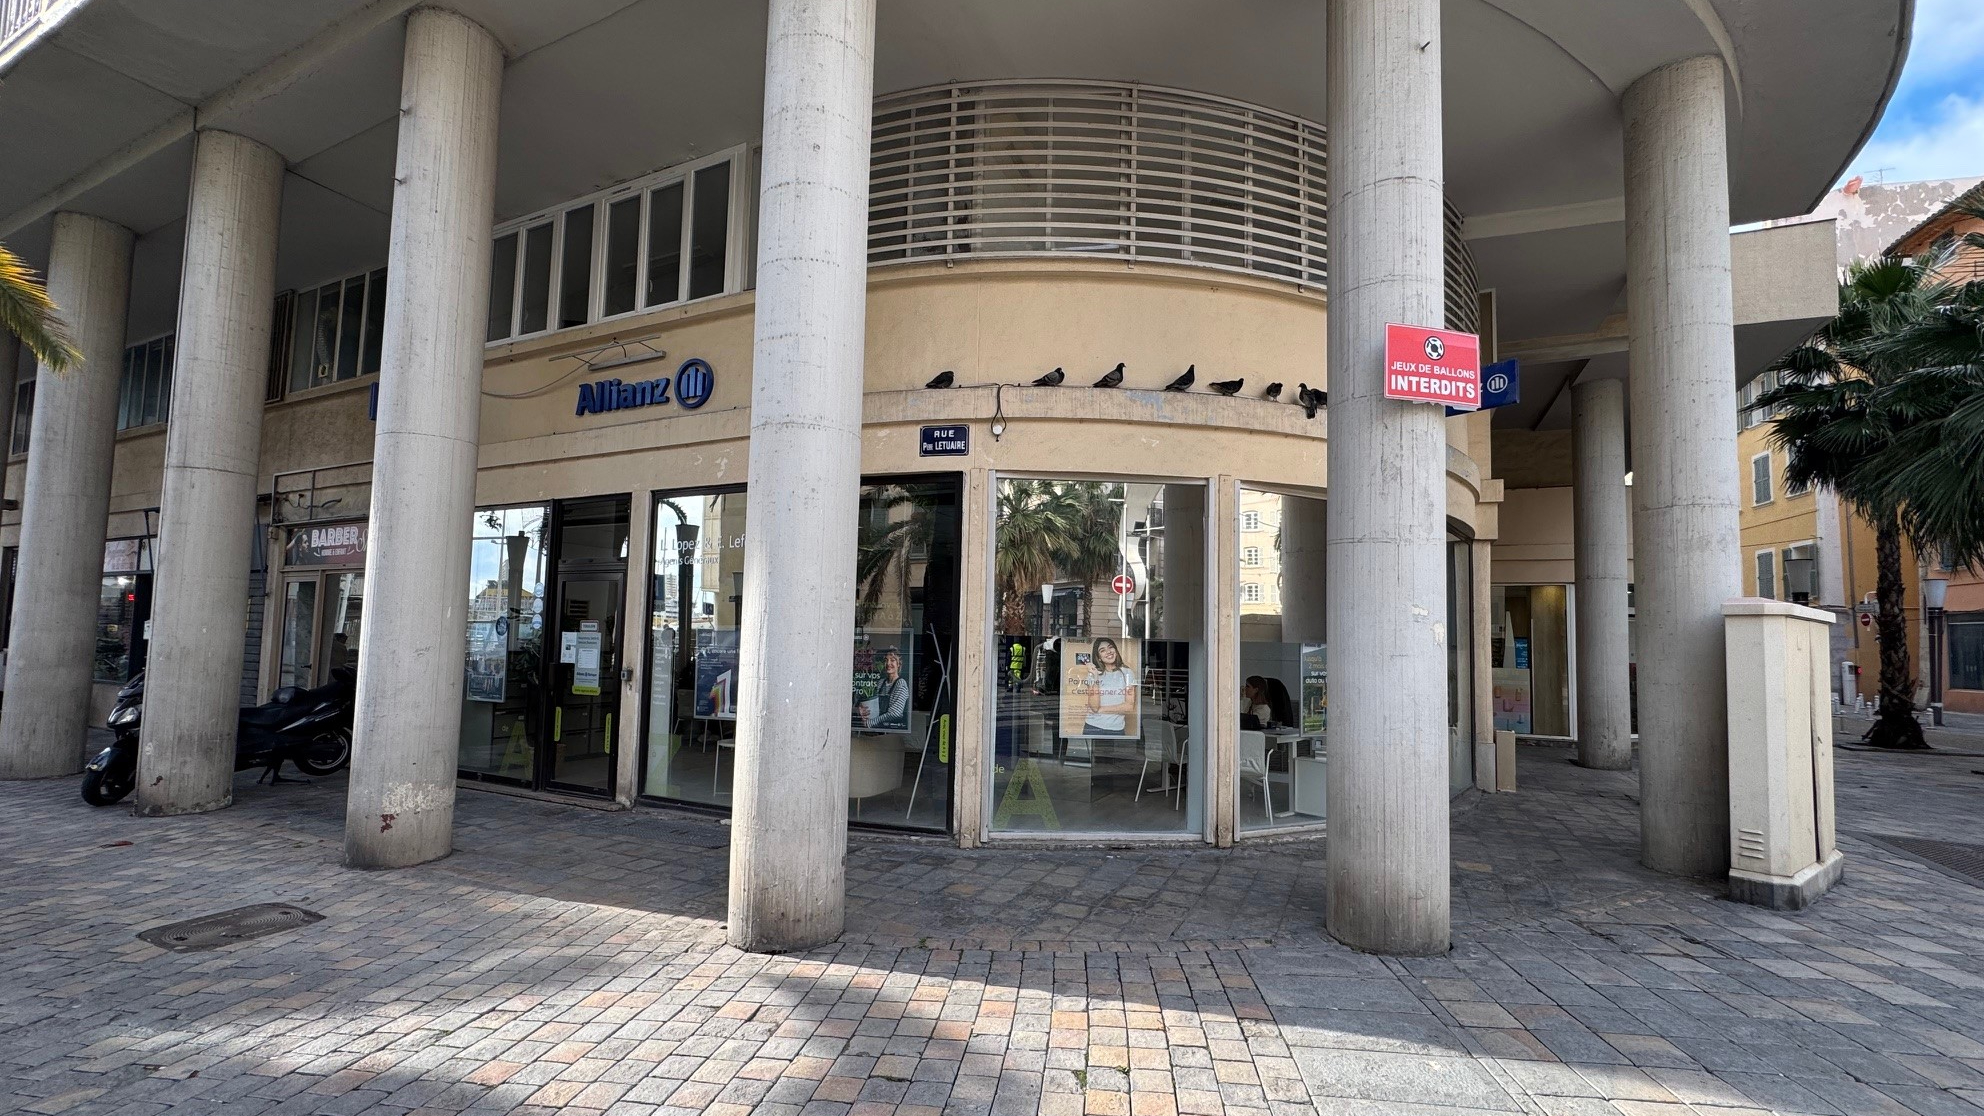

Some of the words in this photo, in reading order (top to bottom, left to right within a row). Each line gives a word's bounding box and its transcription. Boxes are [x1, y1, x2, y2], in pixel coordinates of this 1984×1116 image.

[1391, 361, 1416, 372] JEUX
[1418, 363, 1432, 373] DE
[1434, 365, 1475, 379] BALLONS
[1390, 374, 1475, 398] INTERDITS
[576, 377, 671, 416] Allianz
[934, 429, 955, 438] RUE
[935, 440, 966, 450] LETUAIRE
[311, 526, 359, 548] BARBER
[672, 539, 700, 554] Lopez
[704, 537, 713, 549] &
[729, 533, 746, 548] Lef
[684, 554, 719, 566] Généraux
[867, 671, 881, 680] vos
[852, 679, 878, 688] ontrats
[992, 763, 1005, 774] de
[993, 758, 1061, 829] A
